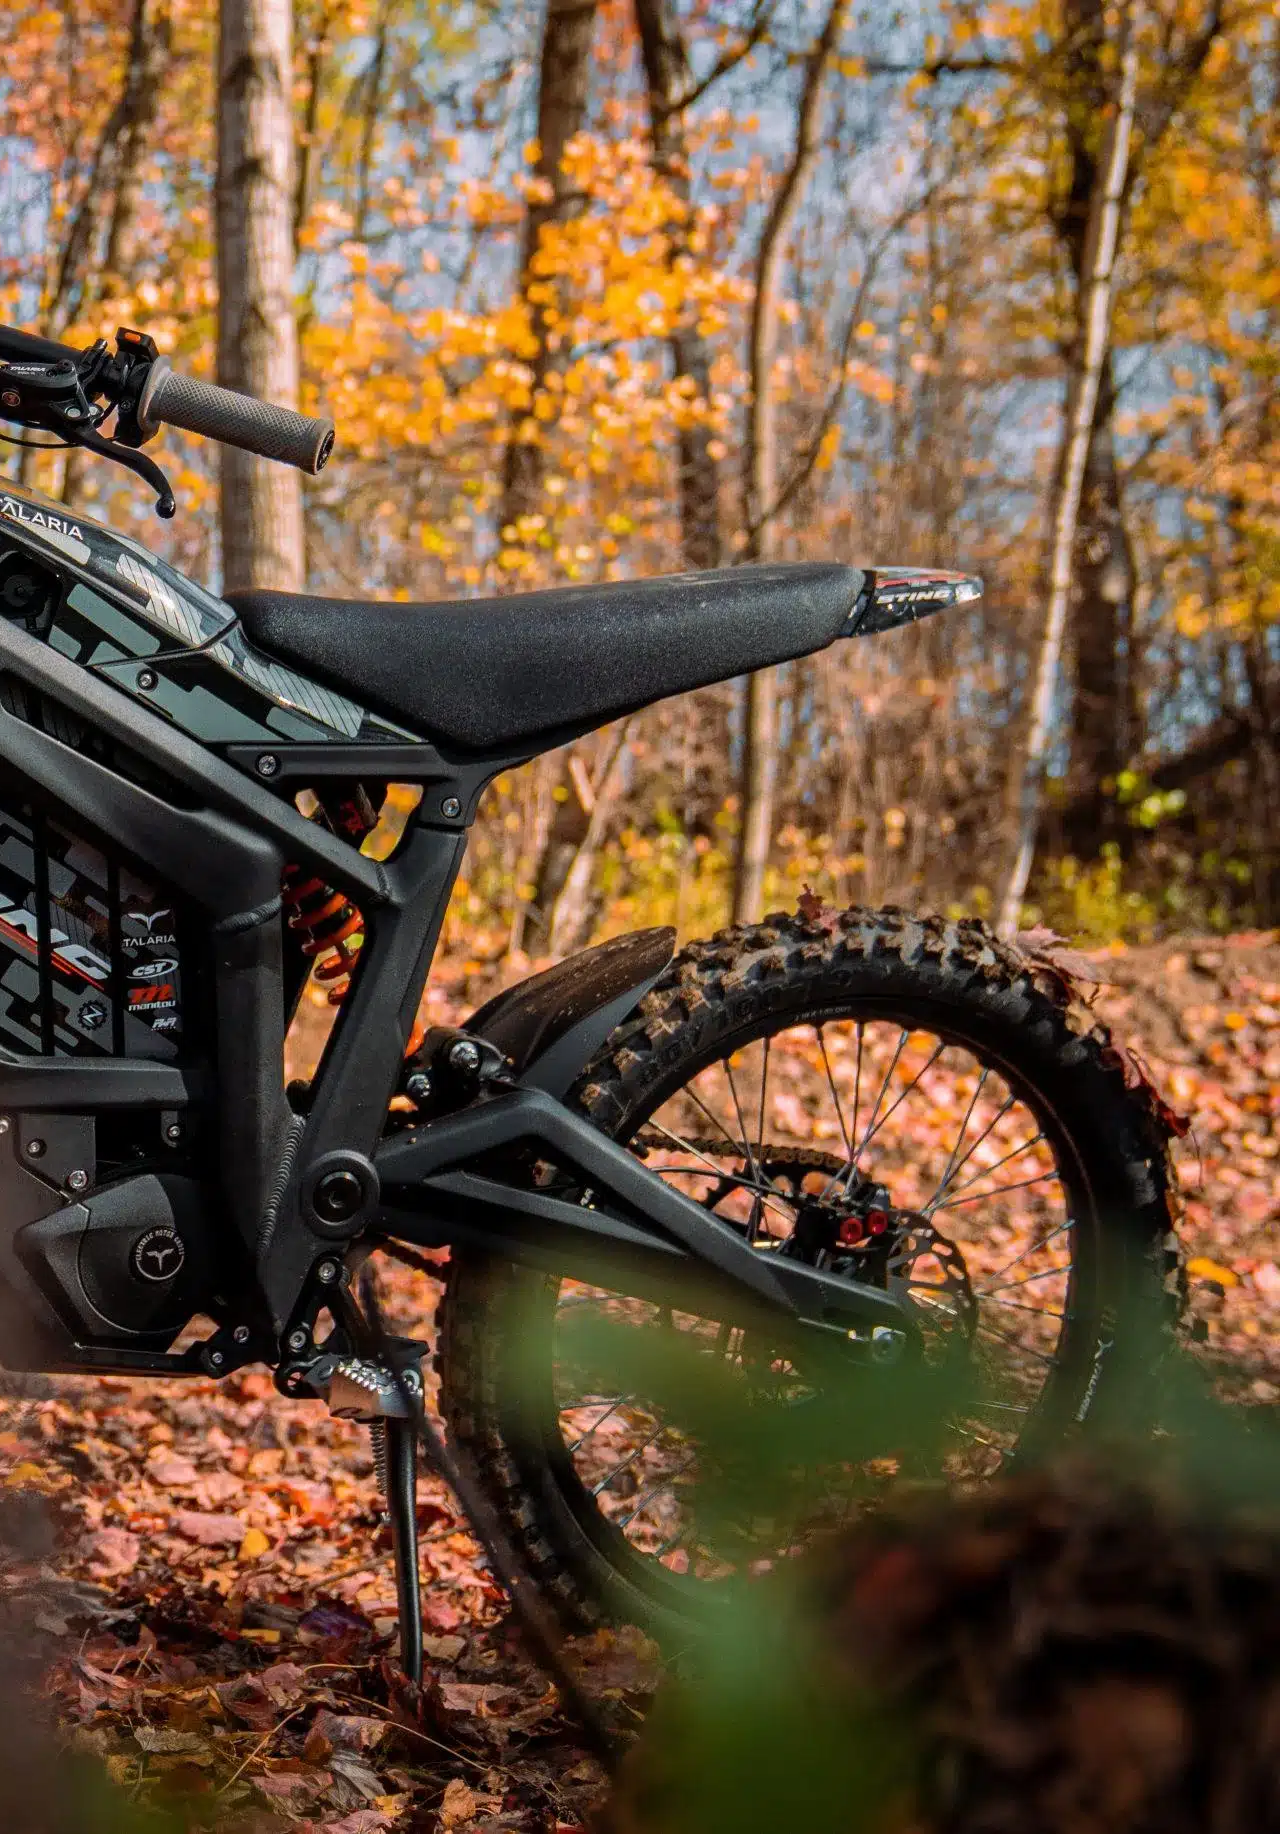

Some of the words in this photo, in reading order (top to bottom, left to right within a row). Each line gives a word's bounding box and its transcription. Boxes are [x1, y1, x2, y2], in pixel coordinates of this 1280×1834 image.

[123, 934, 176, 947] TALARIA
[132, 962, 167, 977] CST
[128, 1000, 176, 1011] manitou
